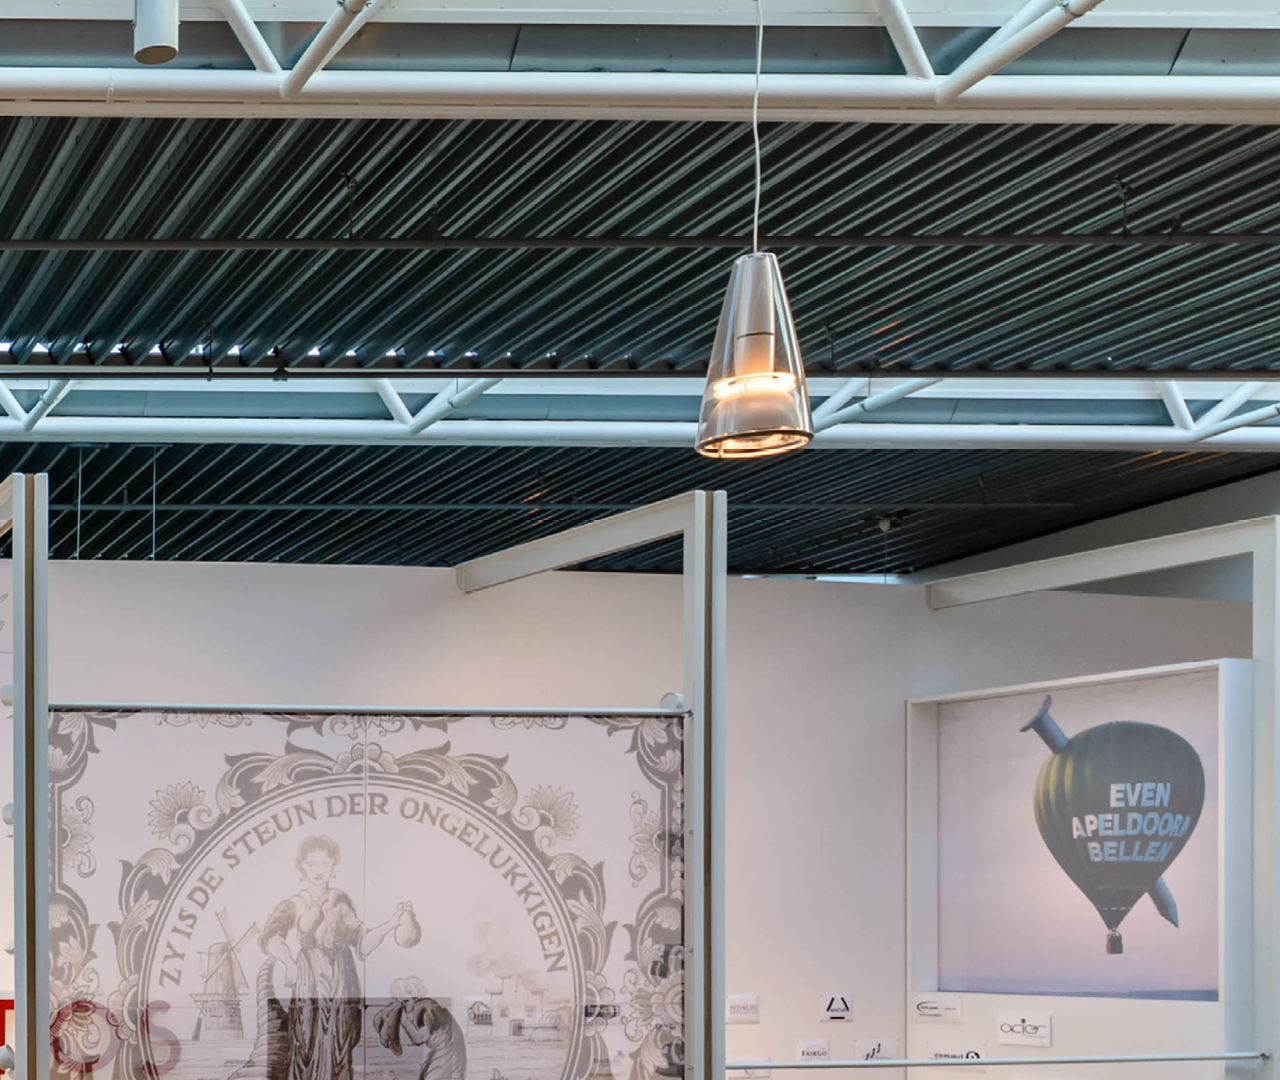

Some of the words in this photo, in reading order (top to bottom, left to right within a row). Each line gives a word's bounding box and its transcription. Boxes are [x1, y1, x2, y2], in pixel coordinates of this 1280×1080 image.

[325, 790, 389, 817] DER
[1109, 782, 1171, 807] EVEN
[224, 798, 320, 870] STEUN
[1072, 812, 1191, 839] APELDOORN
[1087, 840, 1174, 862] BELLEN
[189, 867, 225, 913] DE
[399, 796, 569, 973] ONGELUKKIGEN
[178, 905, 201, 941] IS
